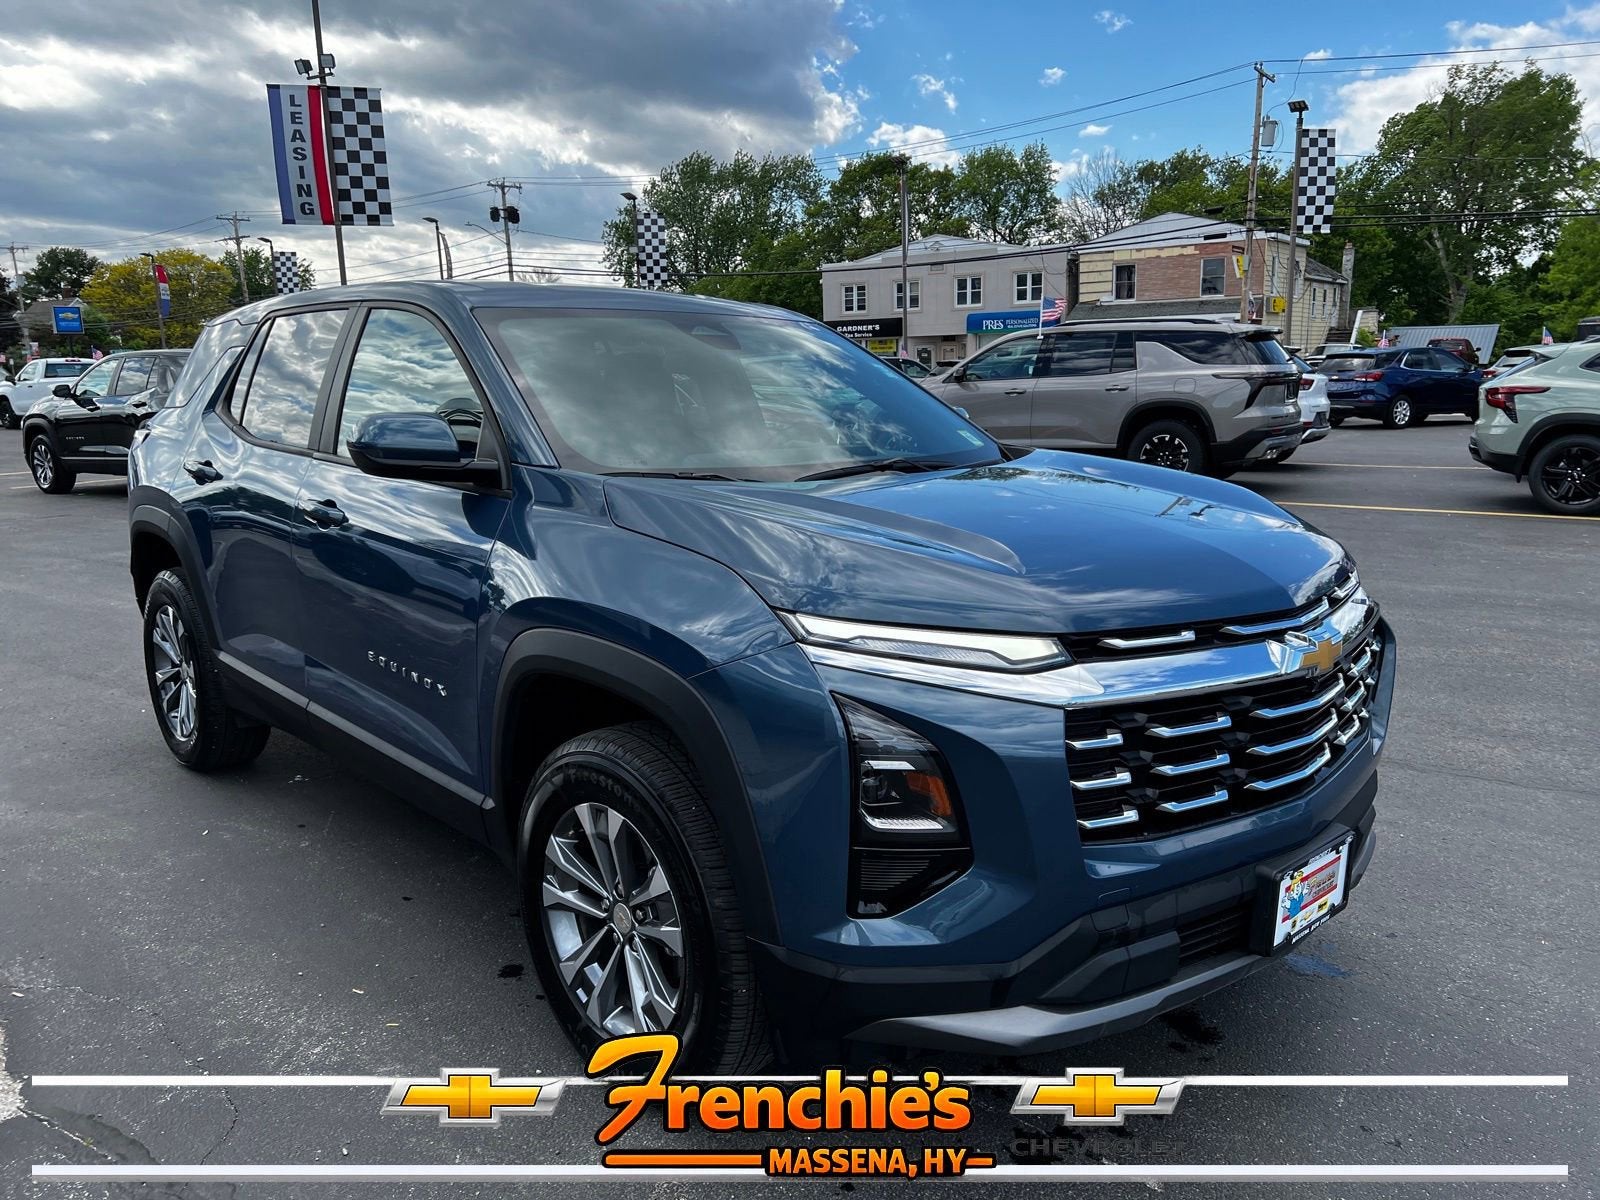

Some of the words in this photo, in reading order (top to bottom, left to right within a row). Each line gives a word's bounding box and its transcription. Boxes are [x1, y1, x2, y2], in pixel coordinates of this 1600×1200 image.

[289, 94, 315, 216] LEASING
[836, 324, 880, 332] GARDNER'S
[982, 319, 1004, 330] PRES
[367, 650, 447, 697] EQUINOX
